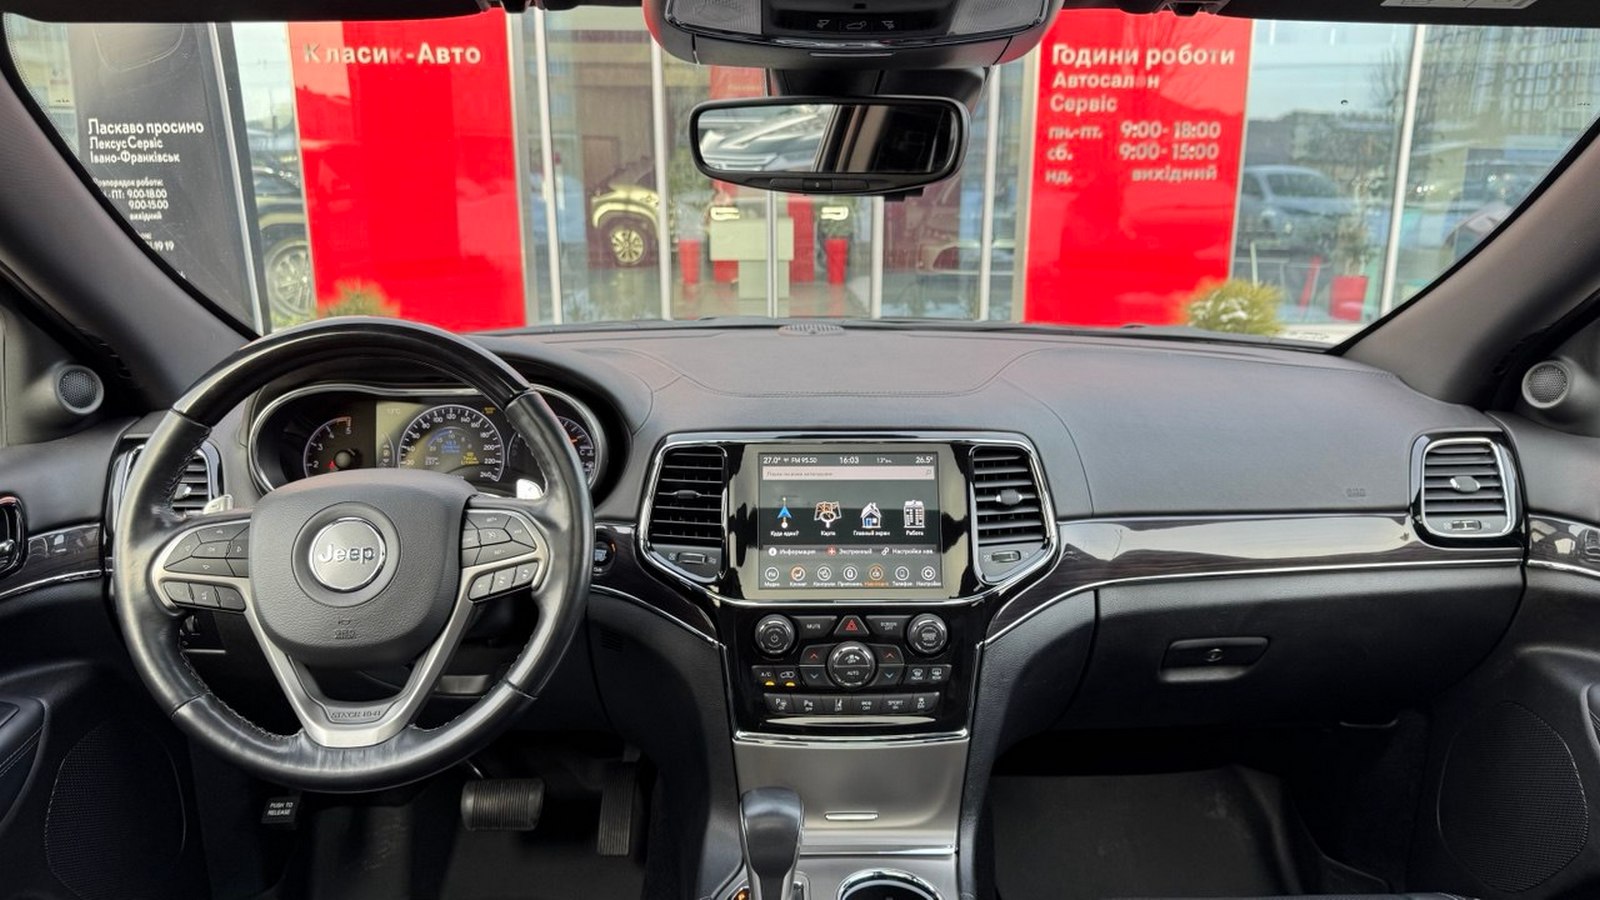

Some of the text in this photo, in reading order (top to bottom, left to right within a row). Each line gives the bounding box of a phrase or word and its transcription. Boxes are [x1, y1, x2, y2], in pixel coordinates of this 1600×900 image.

[1052, 43, 1235, 70] Години роботи
[1050, 93, 1118, 116] Сервіс
[88, 118, 204, 137] Ласкаво просимо
[90, 150, 181, 165] Івано-Франківськ
[1046, 142, 1074, 161] сб.
[1045, 169, 1073, 185] нд.
[1131, 164, 1217, 182] вихідний
[345, 427, 352, 435] 5
[317, 443, 323, 451] 3
[313, 460, 319, 468] 2
[763, 456, 781, 464] 27.0°
[839, 456, 860, 464] 16:03
[915, 456, 933, 464] 26.5°
[318, 544, 375, 565] Jeep
[892, 547, 921, 556] Настройки
